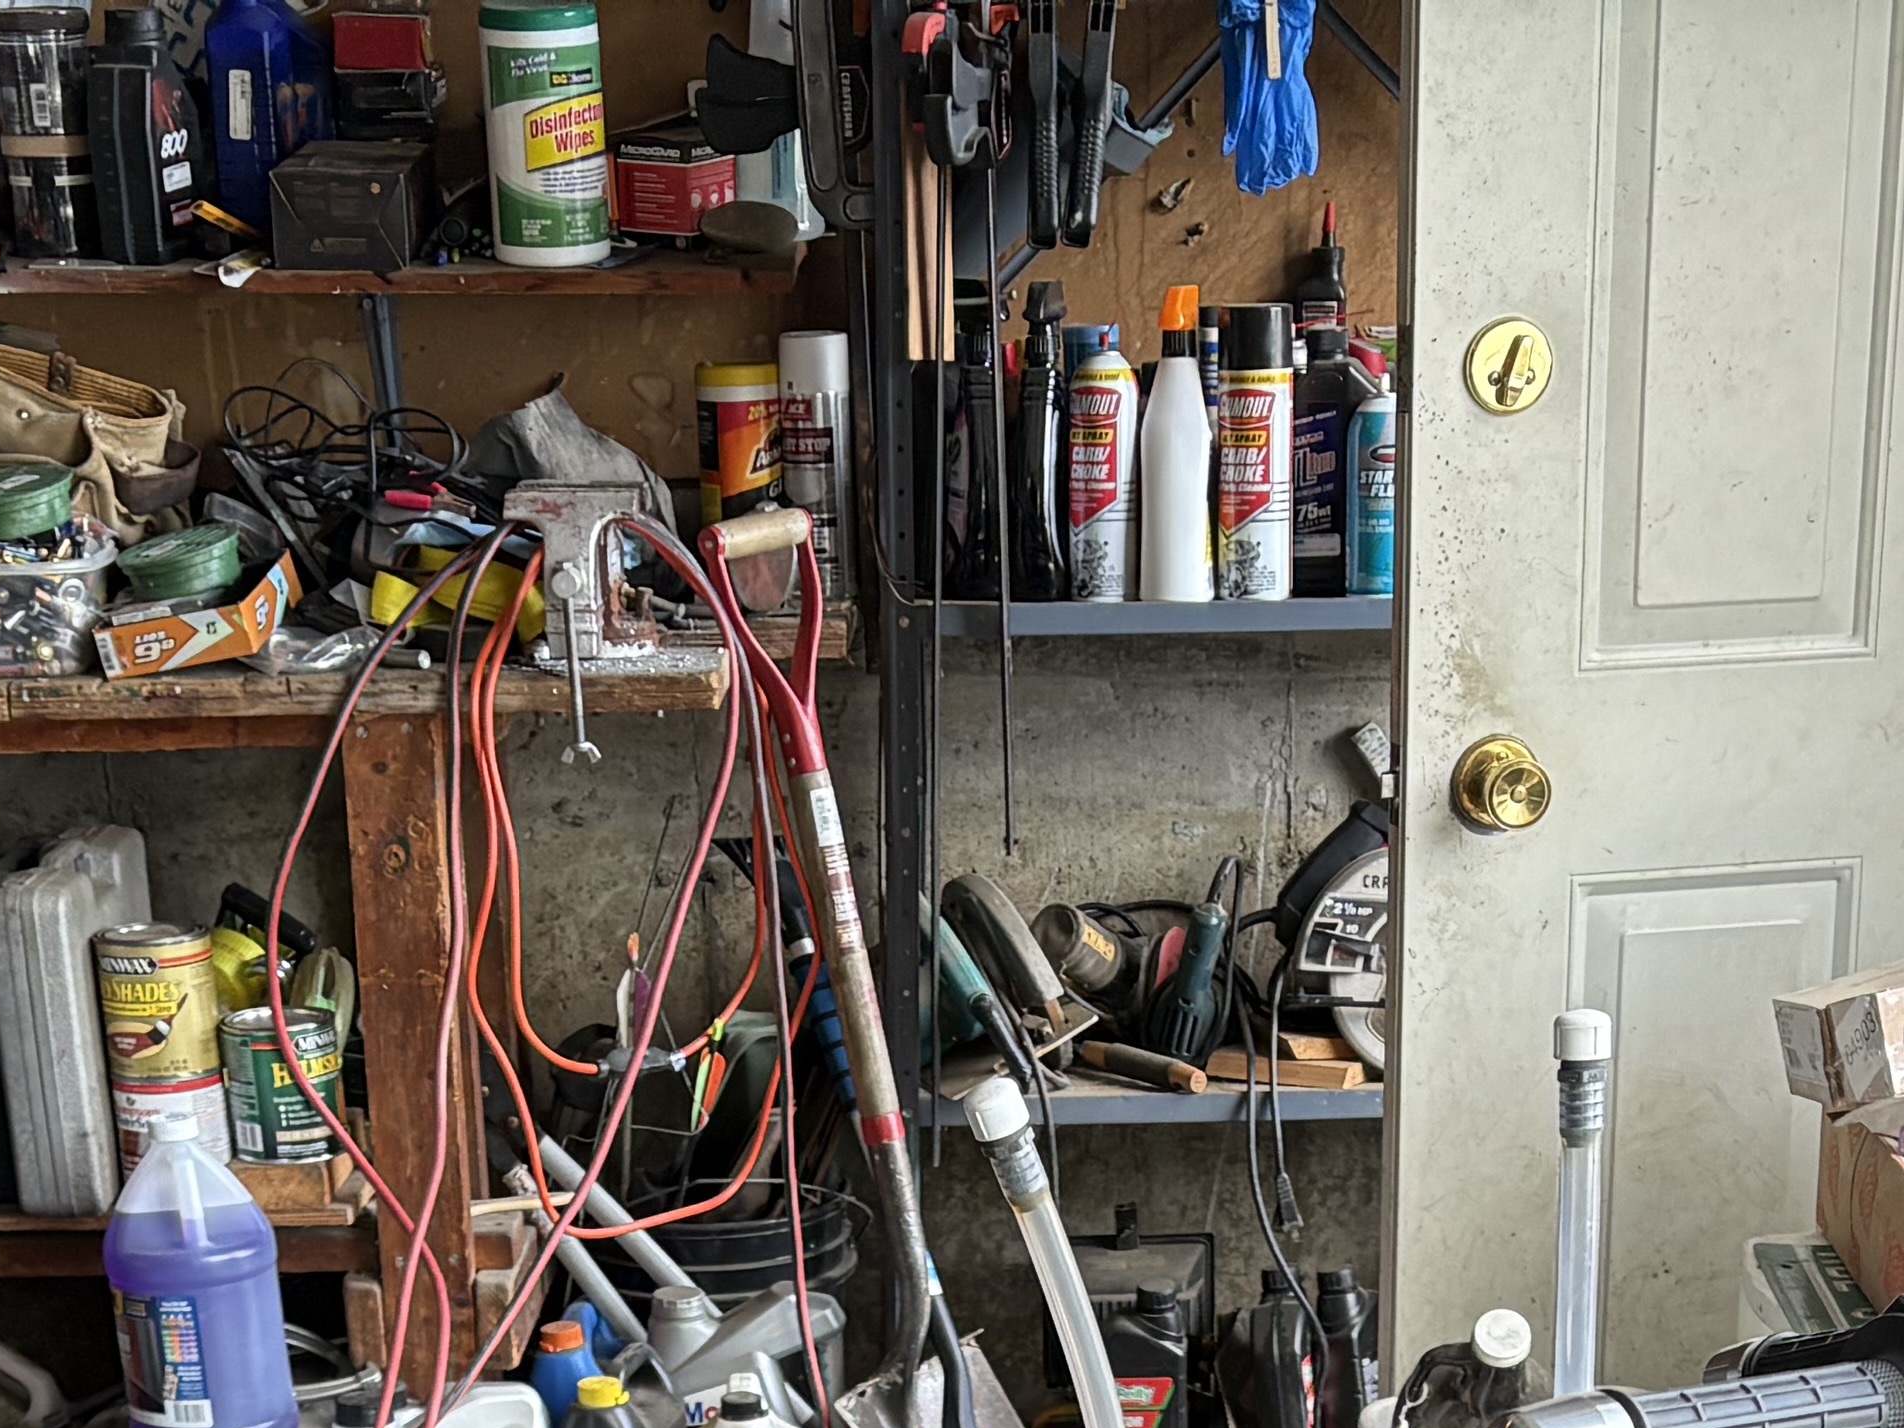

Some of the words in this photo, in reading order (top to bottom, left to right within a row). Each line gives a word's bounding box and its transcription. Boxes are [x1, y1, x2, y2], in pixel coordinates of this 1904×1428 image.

[161, 129, 188, 159] 800
[554, 129, 596, 154] Wipes
[1072, 445, 1111, 462] CARB/
[1220, 446, 1268, 465] CARB/
[1071, 464, 1110, 480] CHOKE
[1220, 464, 1266, 483] CHOKE
